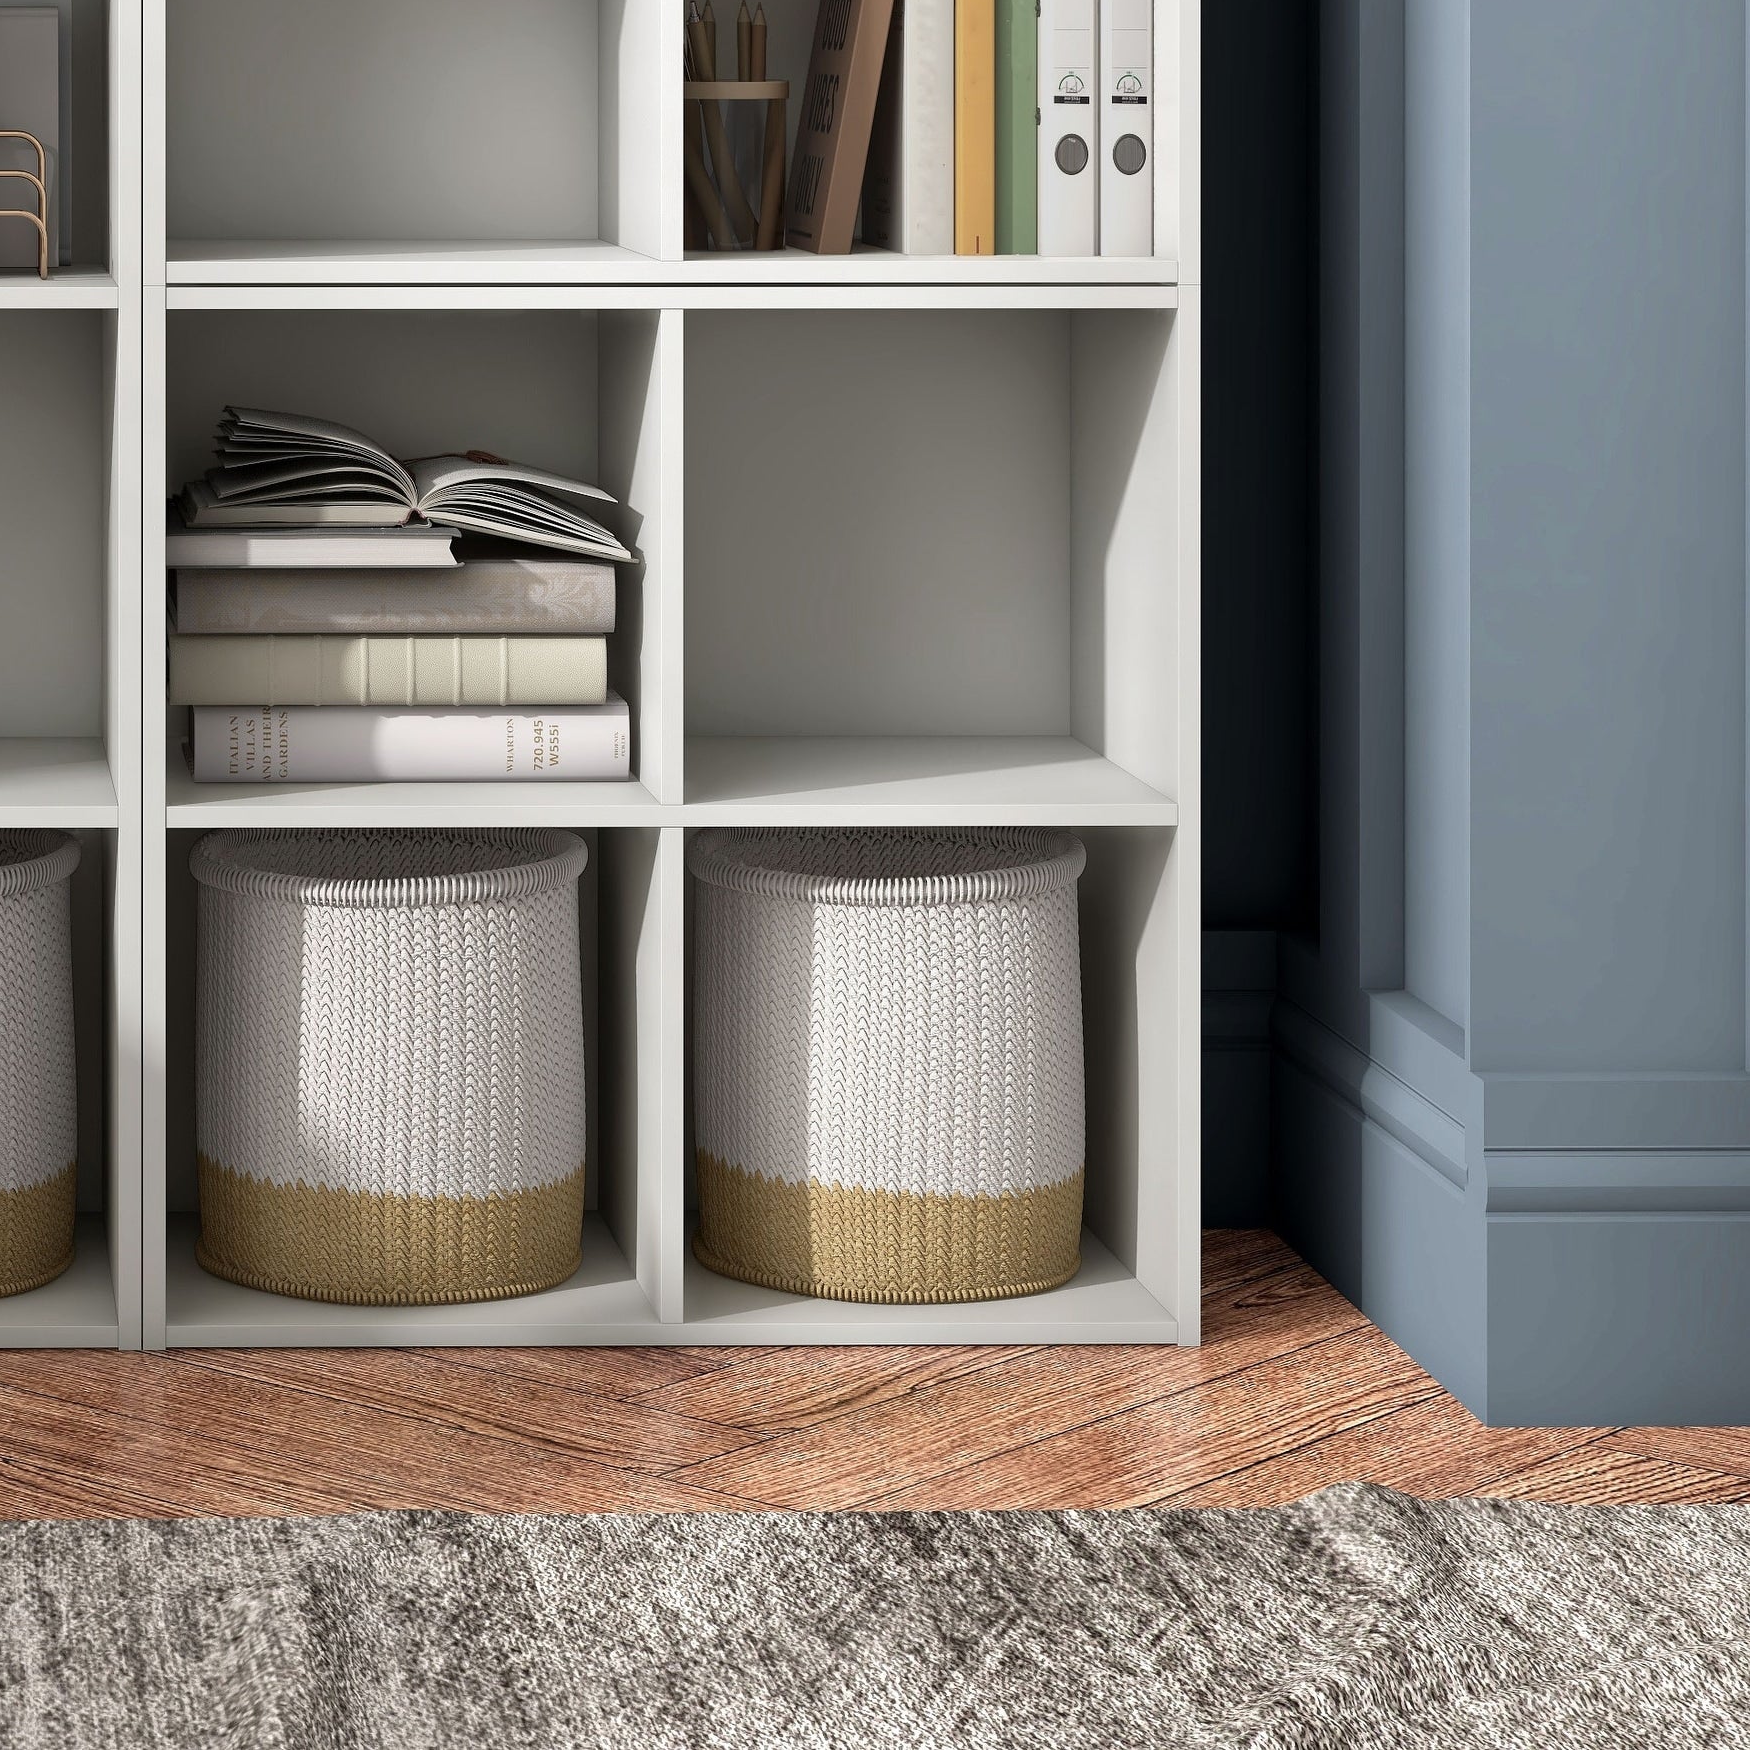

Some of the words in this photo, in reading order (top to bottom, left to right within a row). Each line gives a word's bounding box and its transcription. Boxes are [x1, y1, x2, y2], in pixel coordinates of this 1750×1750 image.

[229, 714, 238, 774] ITALIAN
[246, 719, 255, 770] VILLAS
[262, 705, 271, 750] THEIR
[279, 711, 288, 778] GARDENS
[506, 718, 514, 772] WHARTON
[533, 720, 544, 771] 720.945
[548, 724, 559, 766] W555i
[263, 755, 271, 781] AND
